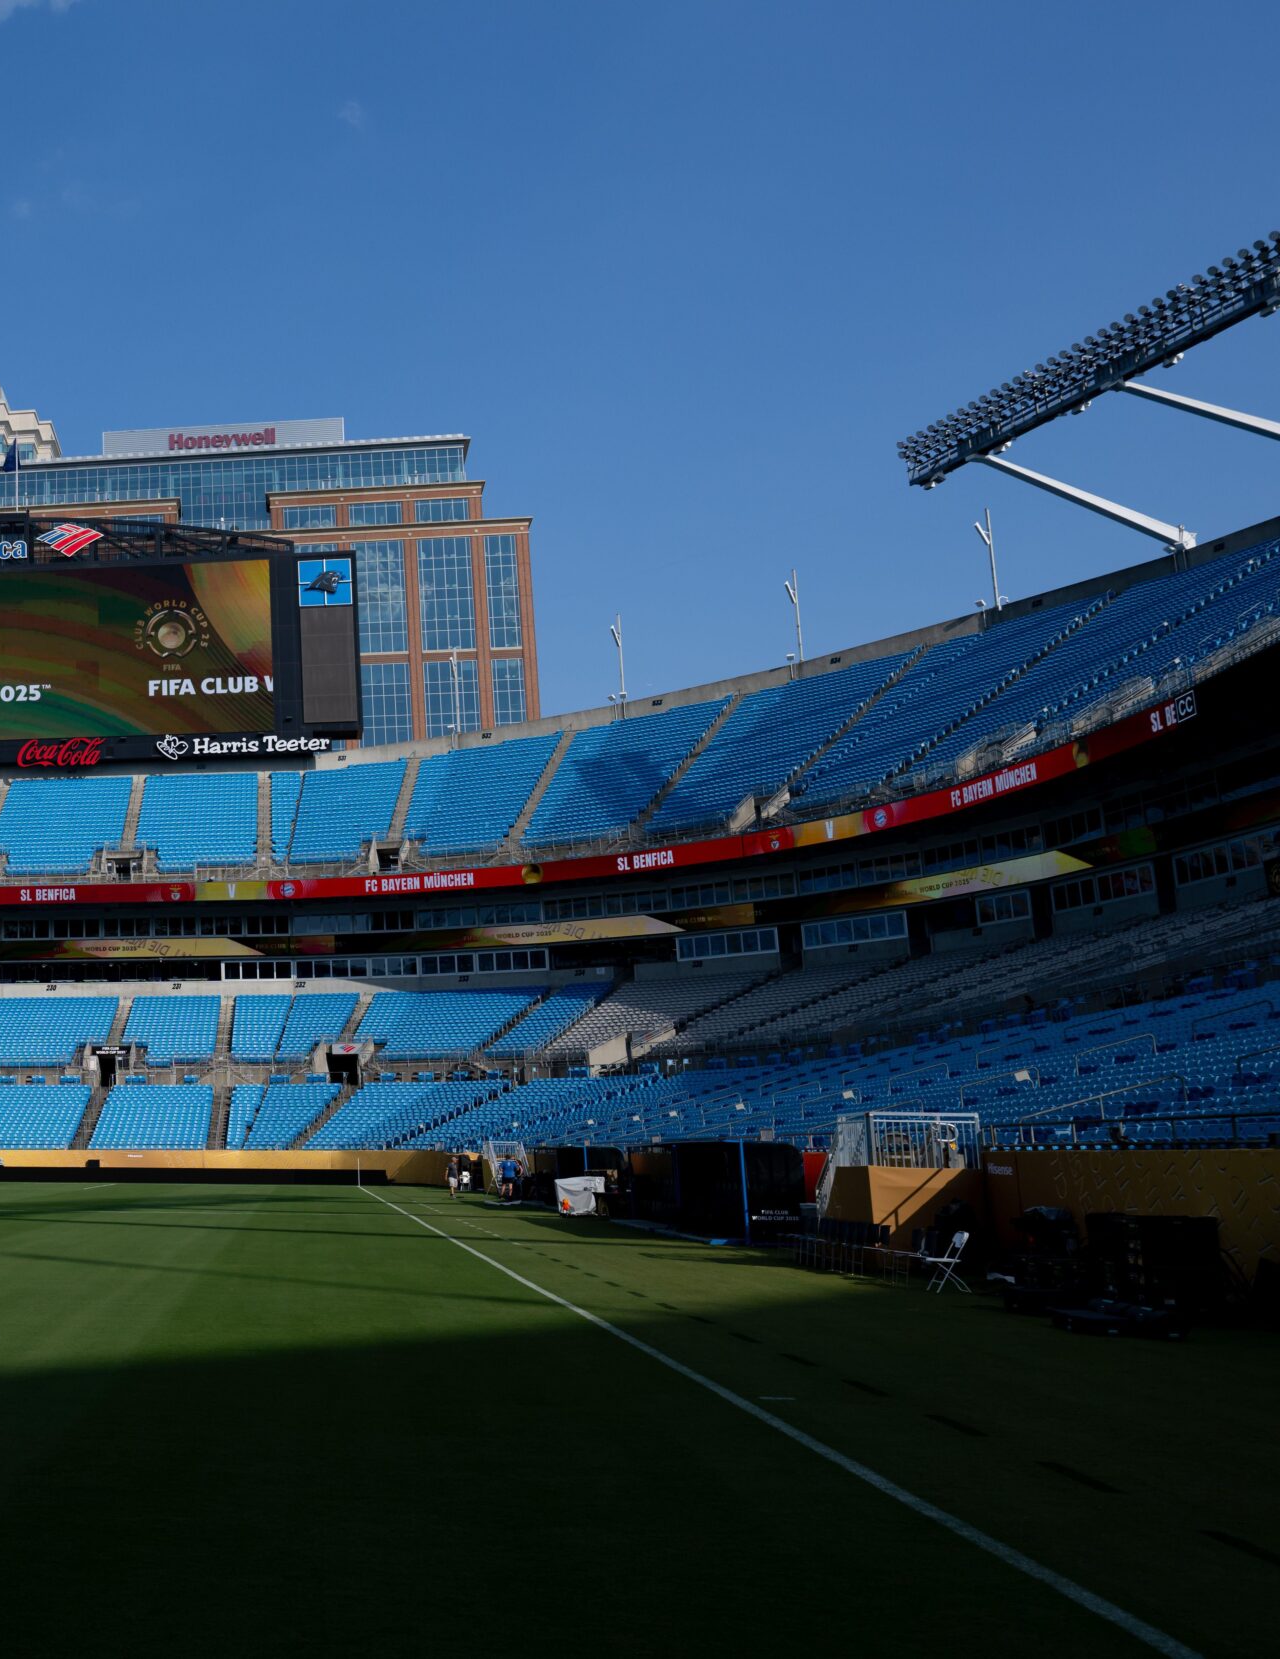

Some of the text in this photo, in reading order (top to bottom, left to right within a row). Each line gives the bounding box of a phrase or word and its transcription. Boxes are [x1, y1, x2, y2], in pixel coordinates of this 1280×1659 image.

[168, 427, 276, 450] Honeywell
[144, 599, 188, 617] WORLD
[190, 606, 210, 630] CUP
[163, 663, 182, 672] FIFA
[148, 678, 196, 697] FIFA
[200, 676, 259, 695] CLUB
[1178, 696, 1194, 716] CC
[1150, 710, 1164, 733] SL
[16, 736, 108, 768] Coca-Cola
[192, 735, 331, 755] Harris Teeter
[950, 762, 1037, 808] FC BAYERN MÜNCHEN
[825, 820, 834, 839] V
[617, 850, 675, 871] SL BENFICA
[227, 883, 236, 898] V
[365, 872, 474, 892] FC BAYERN MÜNCHEN
[919, 884, 941, 894] WORLD
[941, 881, 954, 890] CUP
[20, 888, 76, 901] SL BENFICA
[987, 1162, 1014, 1176] Hisense
